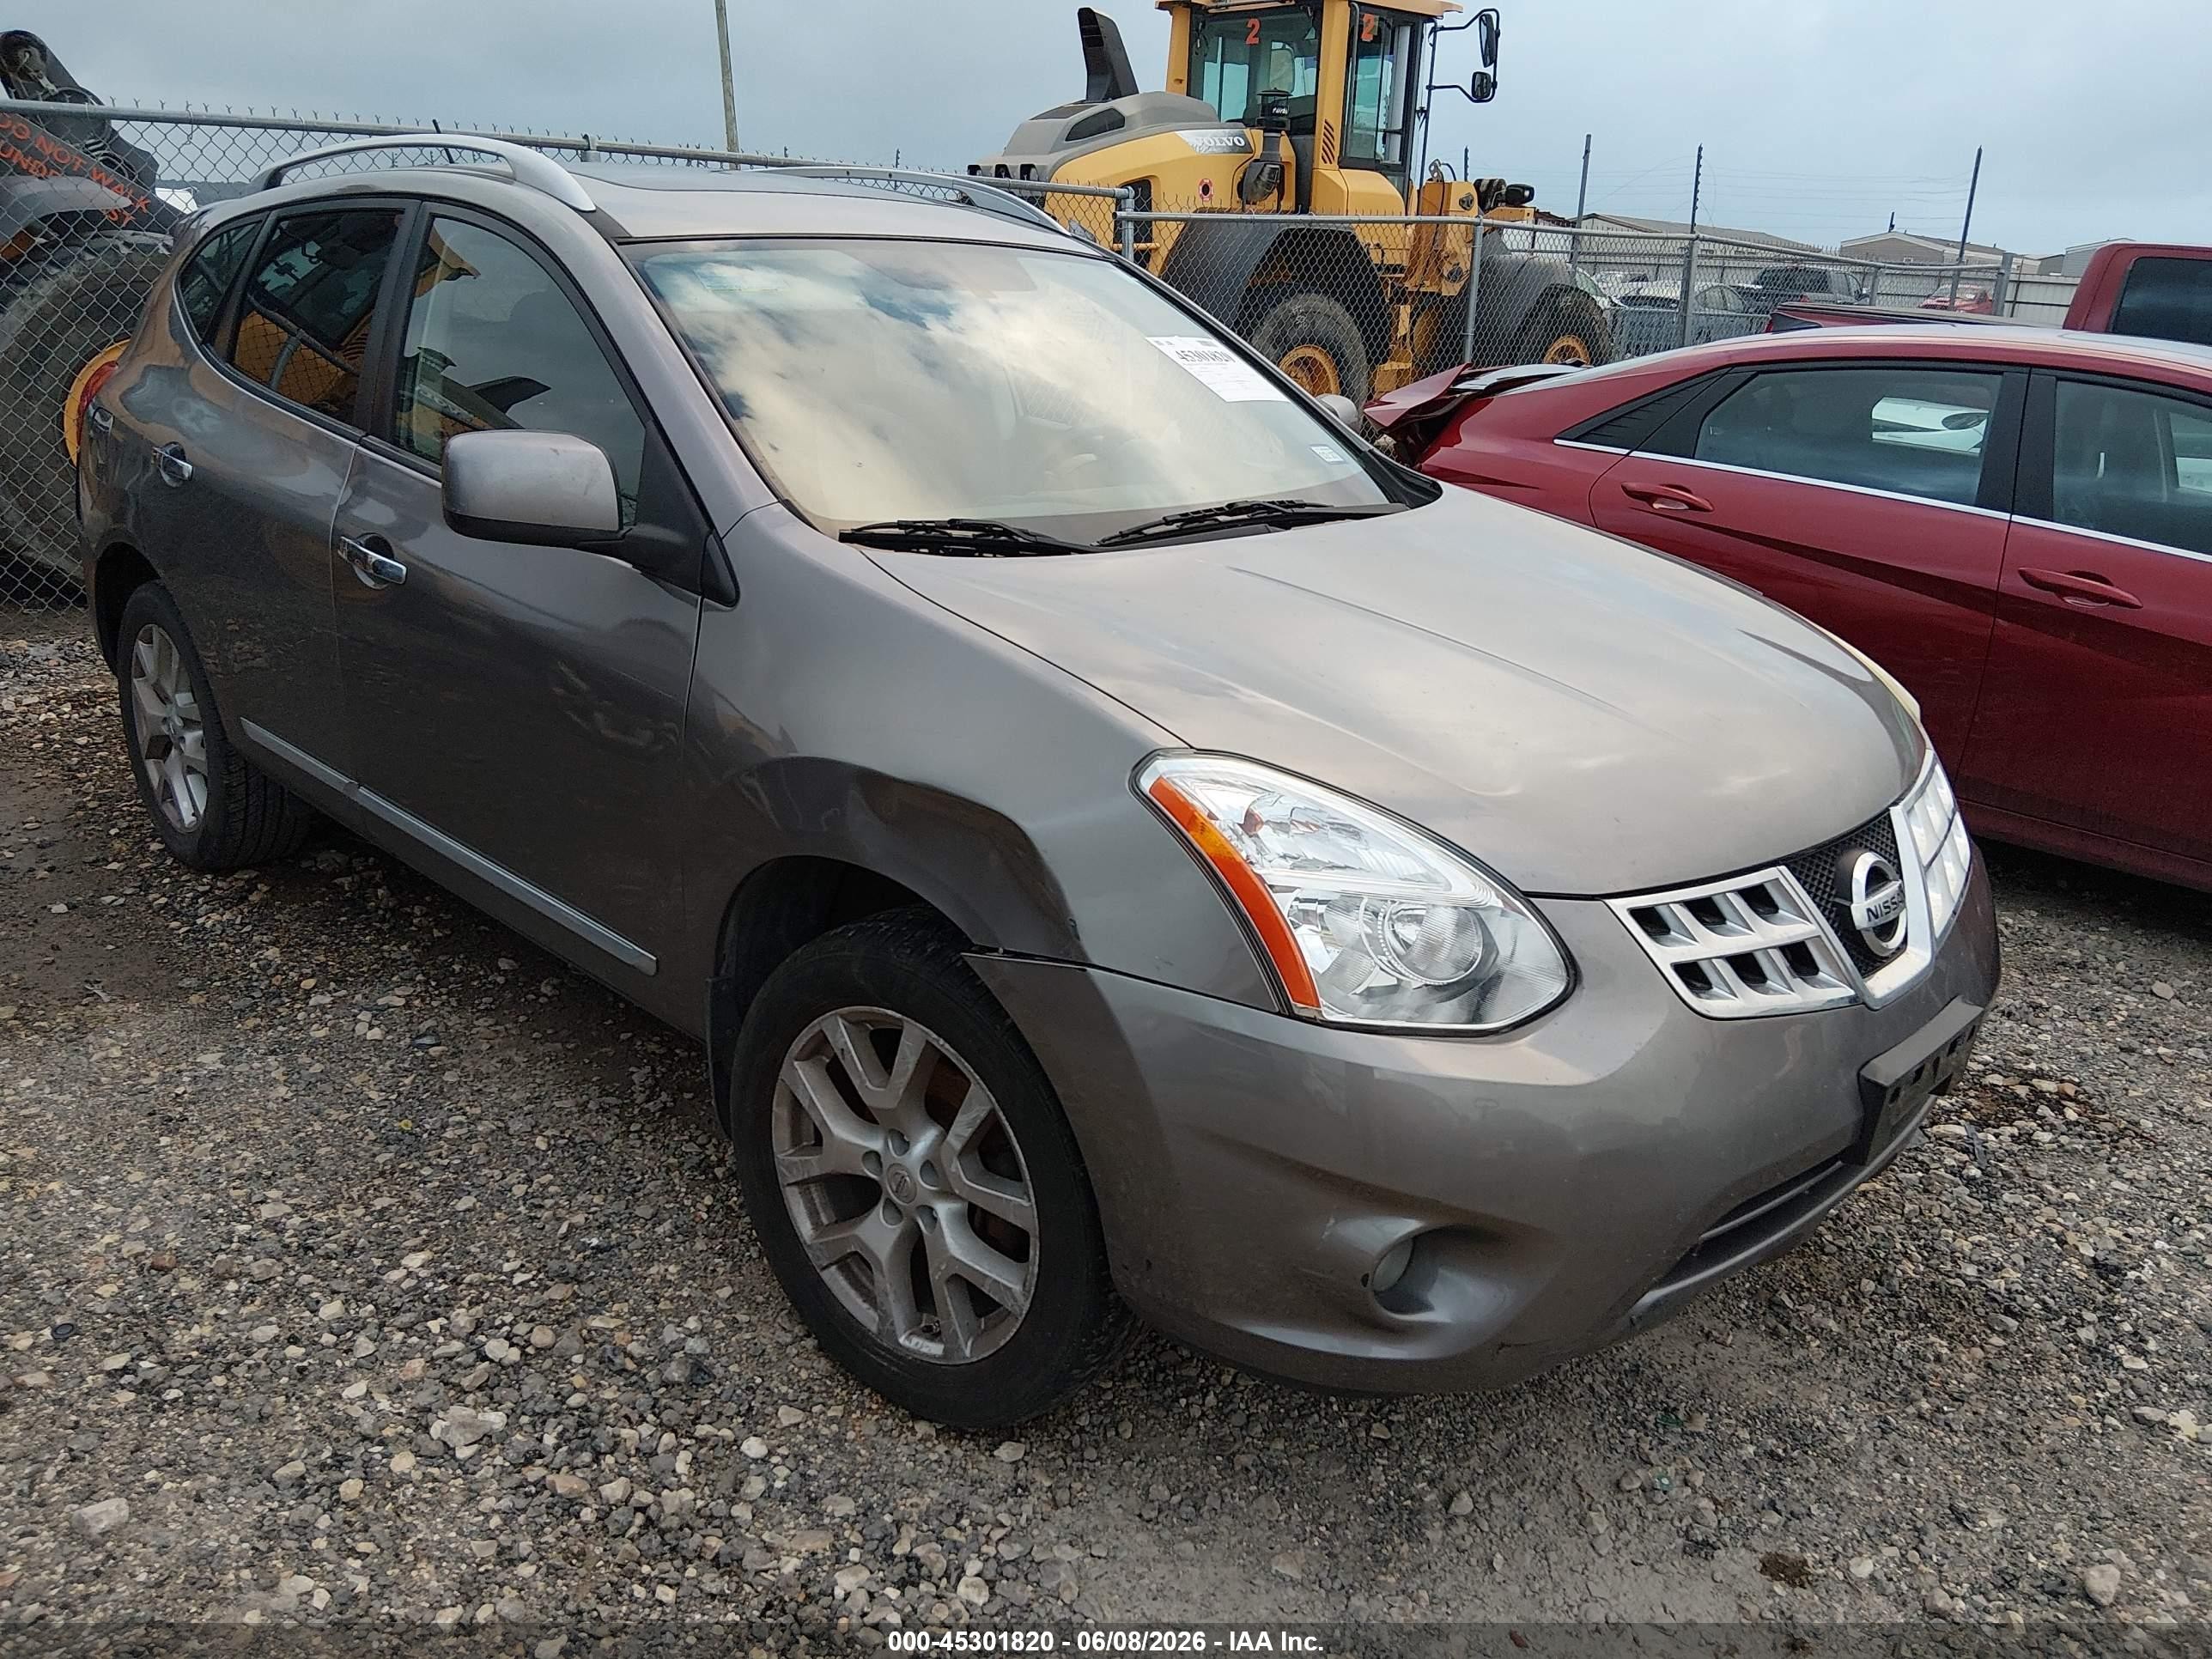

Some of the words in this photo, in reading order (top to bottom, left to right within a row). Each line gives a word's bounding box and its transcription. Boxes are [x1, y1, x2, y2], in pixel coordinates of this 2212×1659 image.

[1245, 18, 1261, 44] 2
[1361, 13, 1376, 41] 2
[1194, 136, 1245, 148] VOLVO
[35, 136, 84, 171] NOT
[90, 166, 152, 214] WALK
[1866, 883, 1905, 922] NISS
